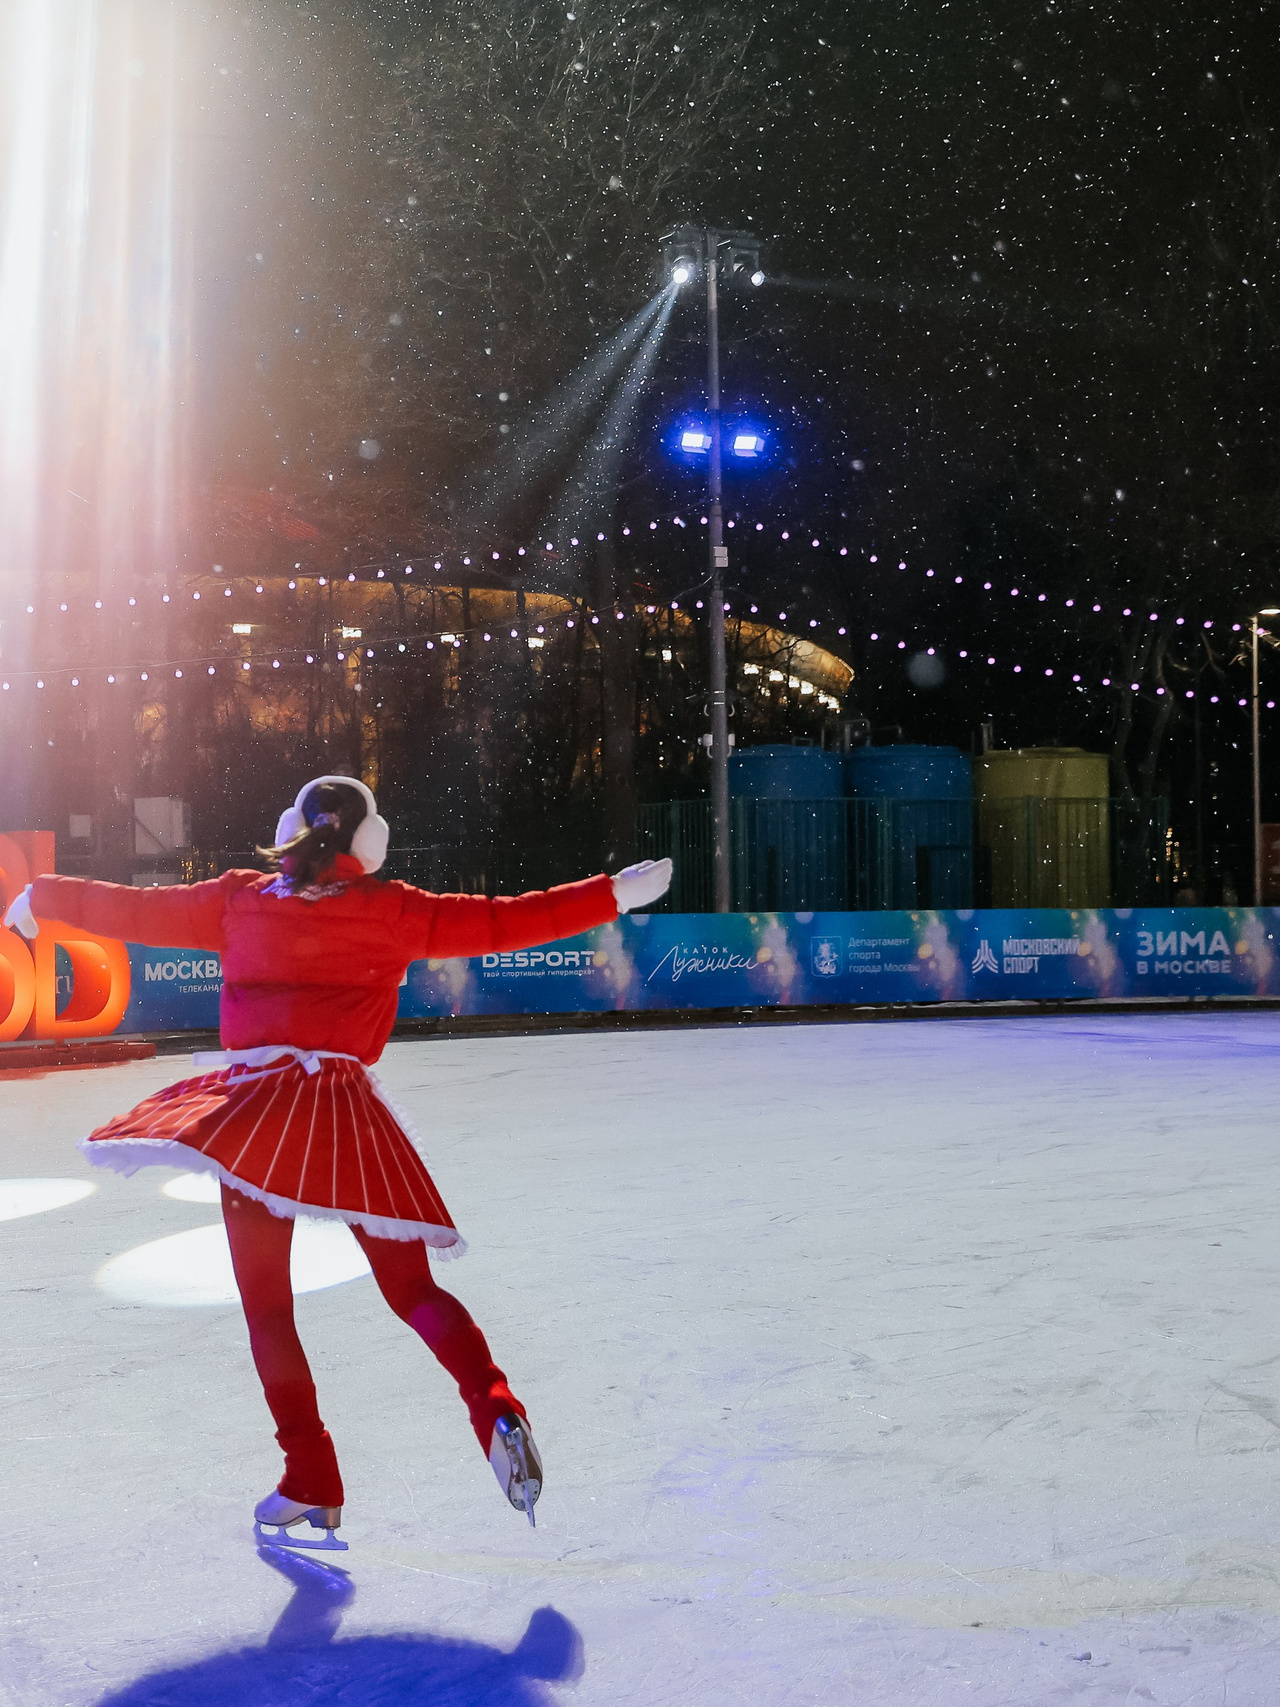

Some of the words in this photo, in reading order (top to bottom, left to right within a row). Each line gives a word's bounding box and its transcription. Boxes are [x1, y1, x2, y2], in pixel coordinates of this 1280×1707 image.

[683, 946, 729, 954] КАТОК
[848, 937, 910, 948] Департамент
[1002, 934, 1080, 956] МОСКОВСКИЙ
[1136, 930, 1231, 957] ЗИМА
[482, 950, 595, 968] DESPORT
[647, 945, 759, 982] Лужники
[848, 951, 881, 961] спорта
[848, 964, 881, 974] города
[883, 962, 920, 972] Москвы
[1003, 956, 1040, 974] СПОРТ
[1136, 960, 1148, 974] В
[1154, 959, 1231, 974] МОСКВЕ
[501, 969, 545, 978] спортивный
[547, 968, 595, 977] гипермаркет
